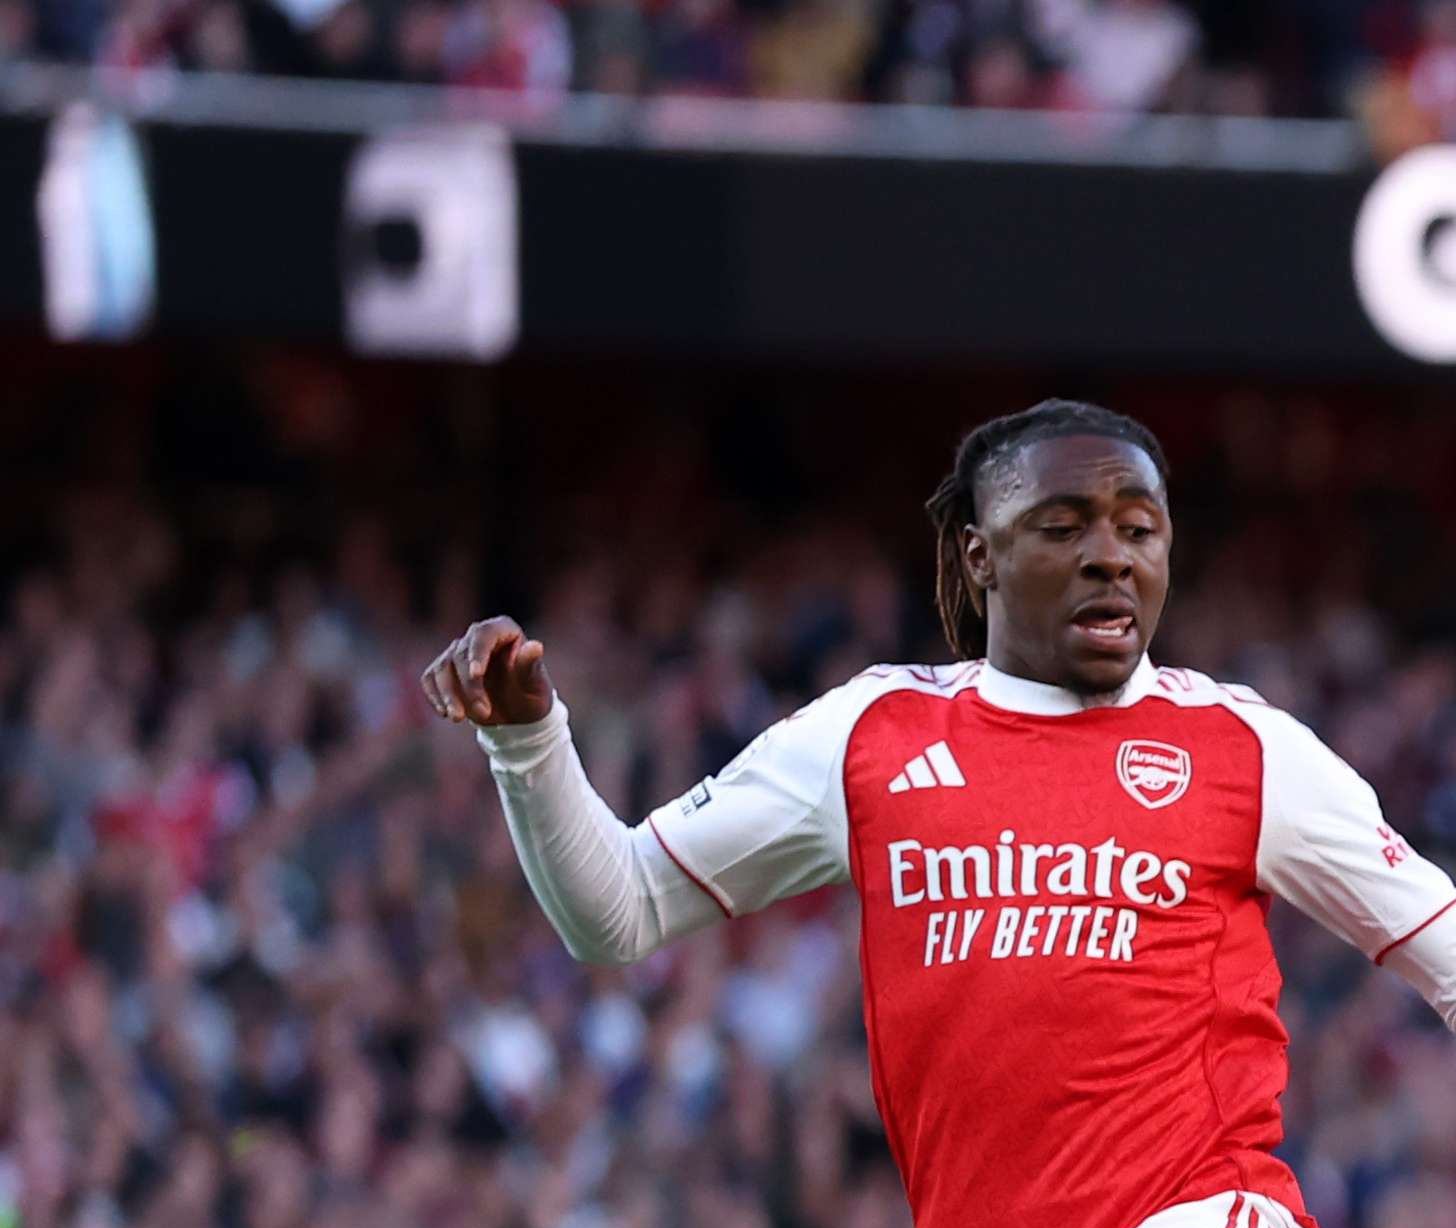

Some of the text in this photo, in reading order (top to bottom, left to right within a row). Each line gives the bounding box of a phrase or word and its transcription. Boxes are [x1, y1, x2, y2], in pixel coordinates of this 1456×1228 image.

[1128, 749, 1180, 770] Arsenal
[888, 829, 1191, 909] Emirates
[924, 905, 1138, 967] FLY BETTER
